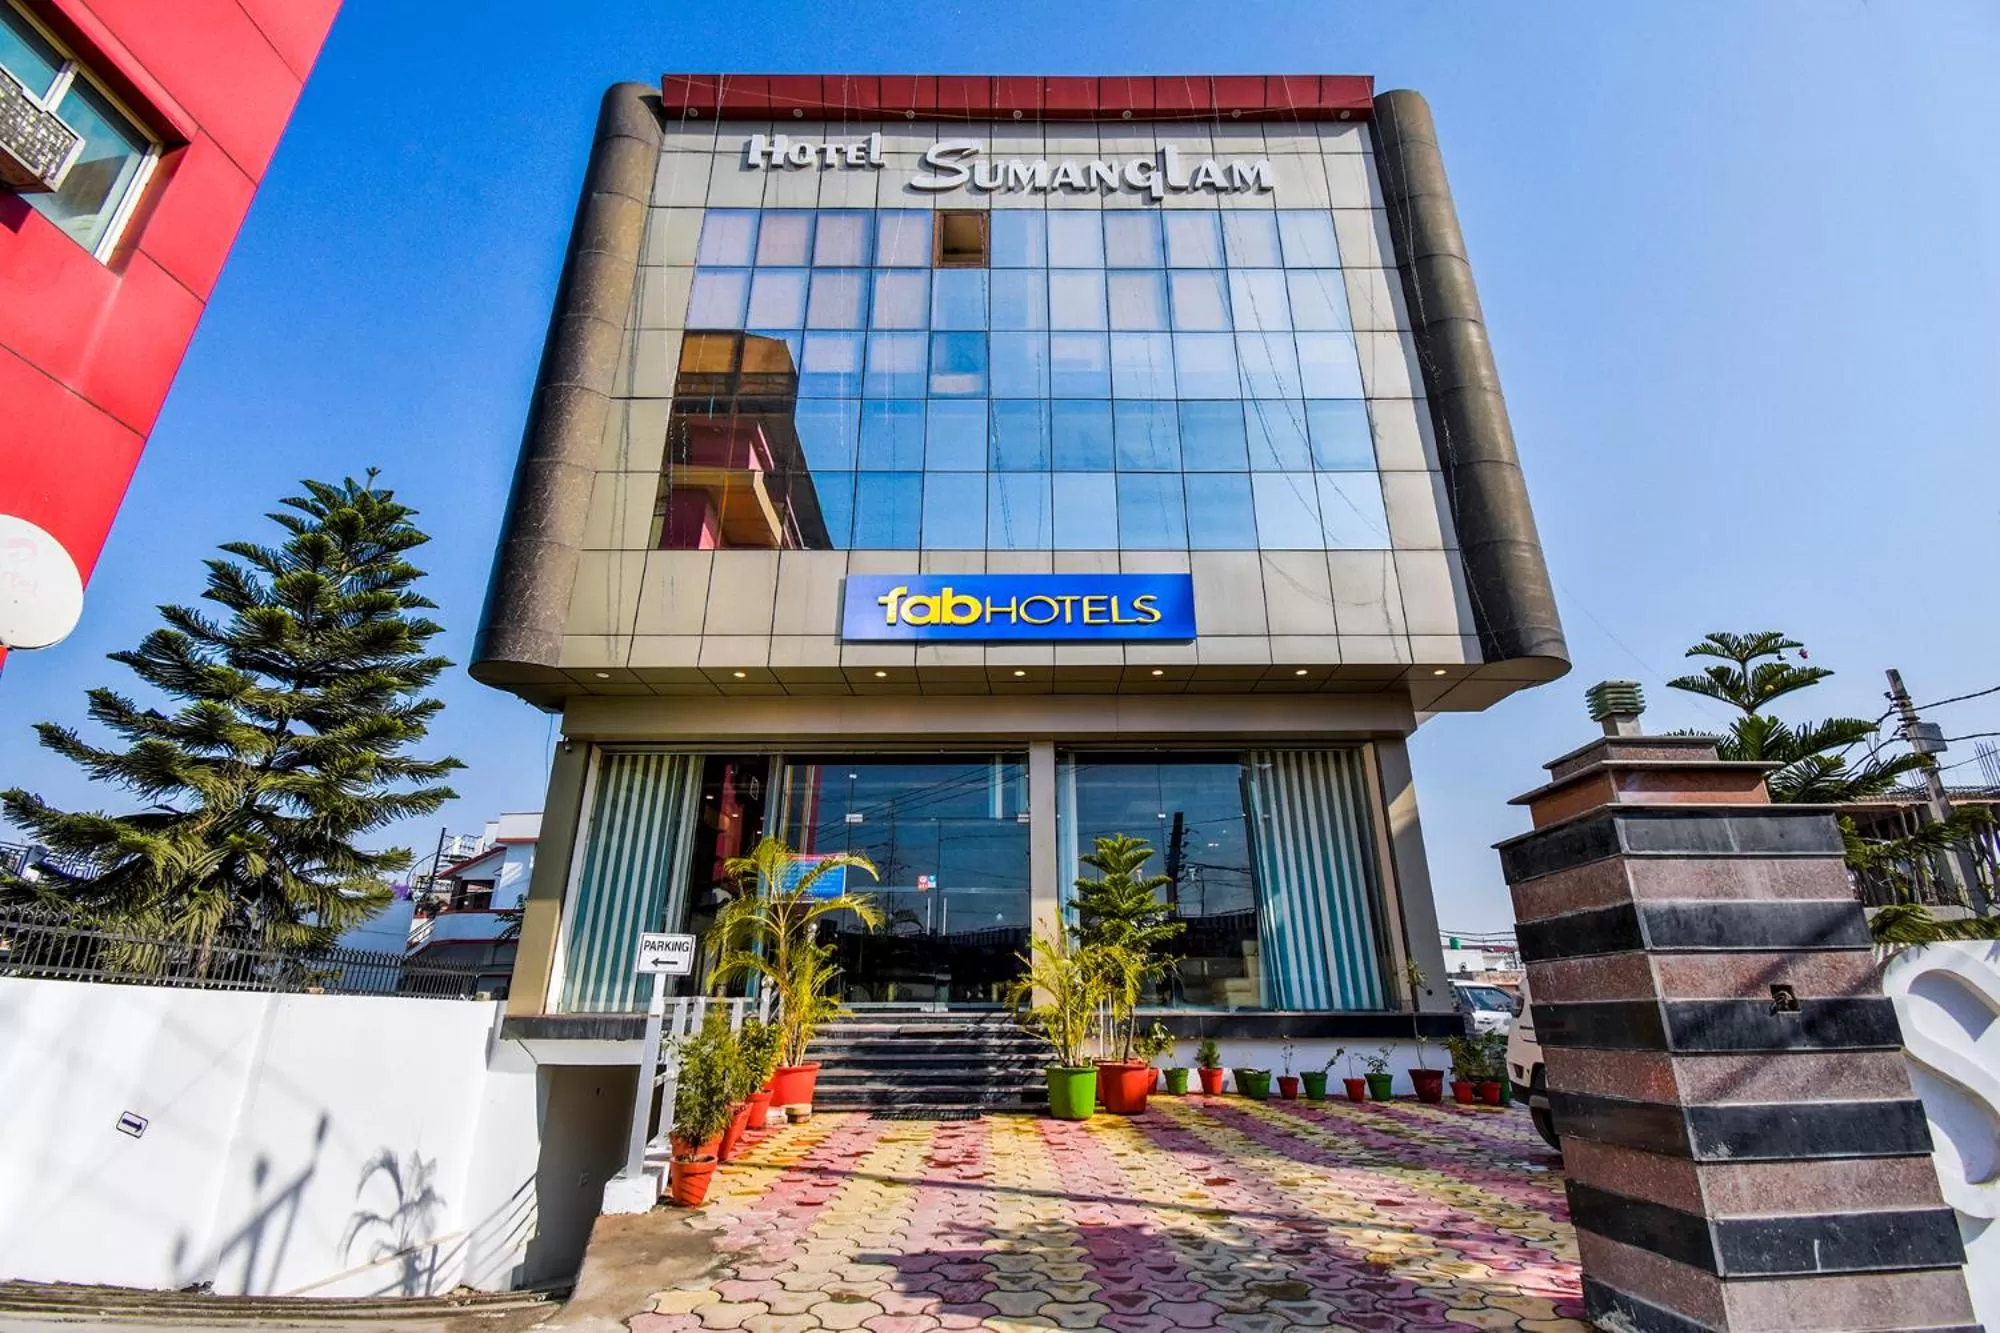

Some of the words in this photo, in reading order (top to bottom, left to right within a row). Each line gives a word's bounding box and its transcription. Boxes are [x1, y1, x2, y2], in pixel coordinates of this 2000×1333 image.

[909, 139, 1275, 200] SUMANGLAM
[877, 586, 1162, 626] fabHOTELS
[643, 940, 689, 953] PARKING
